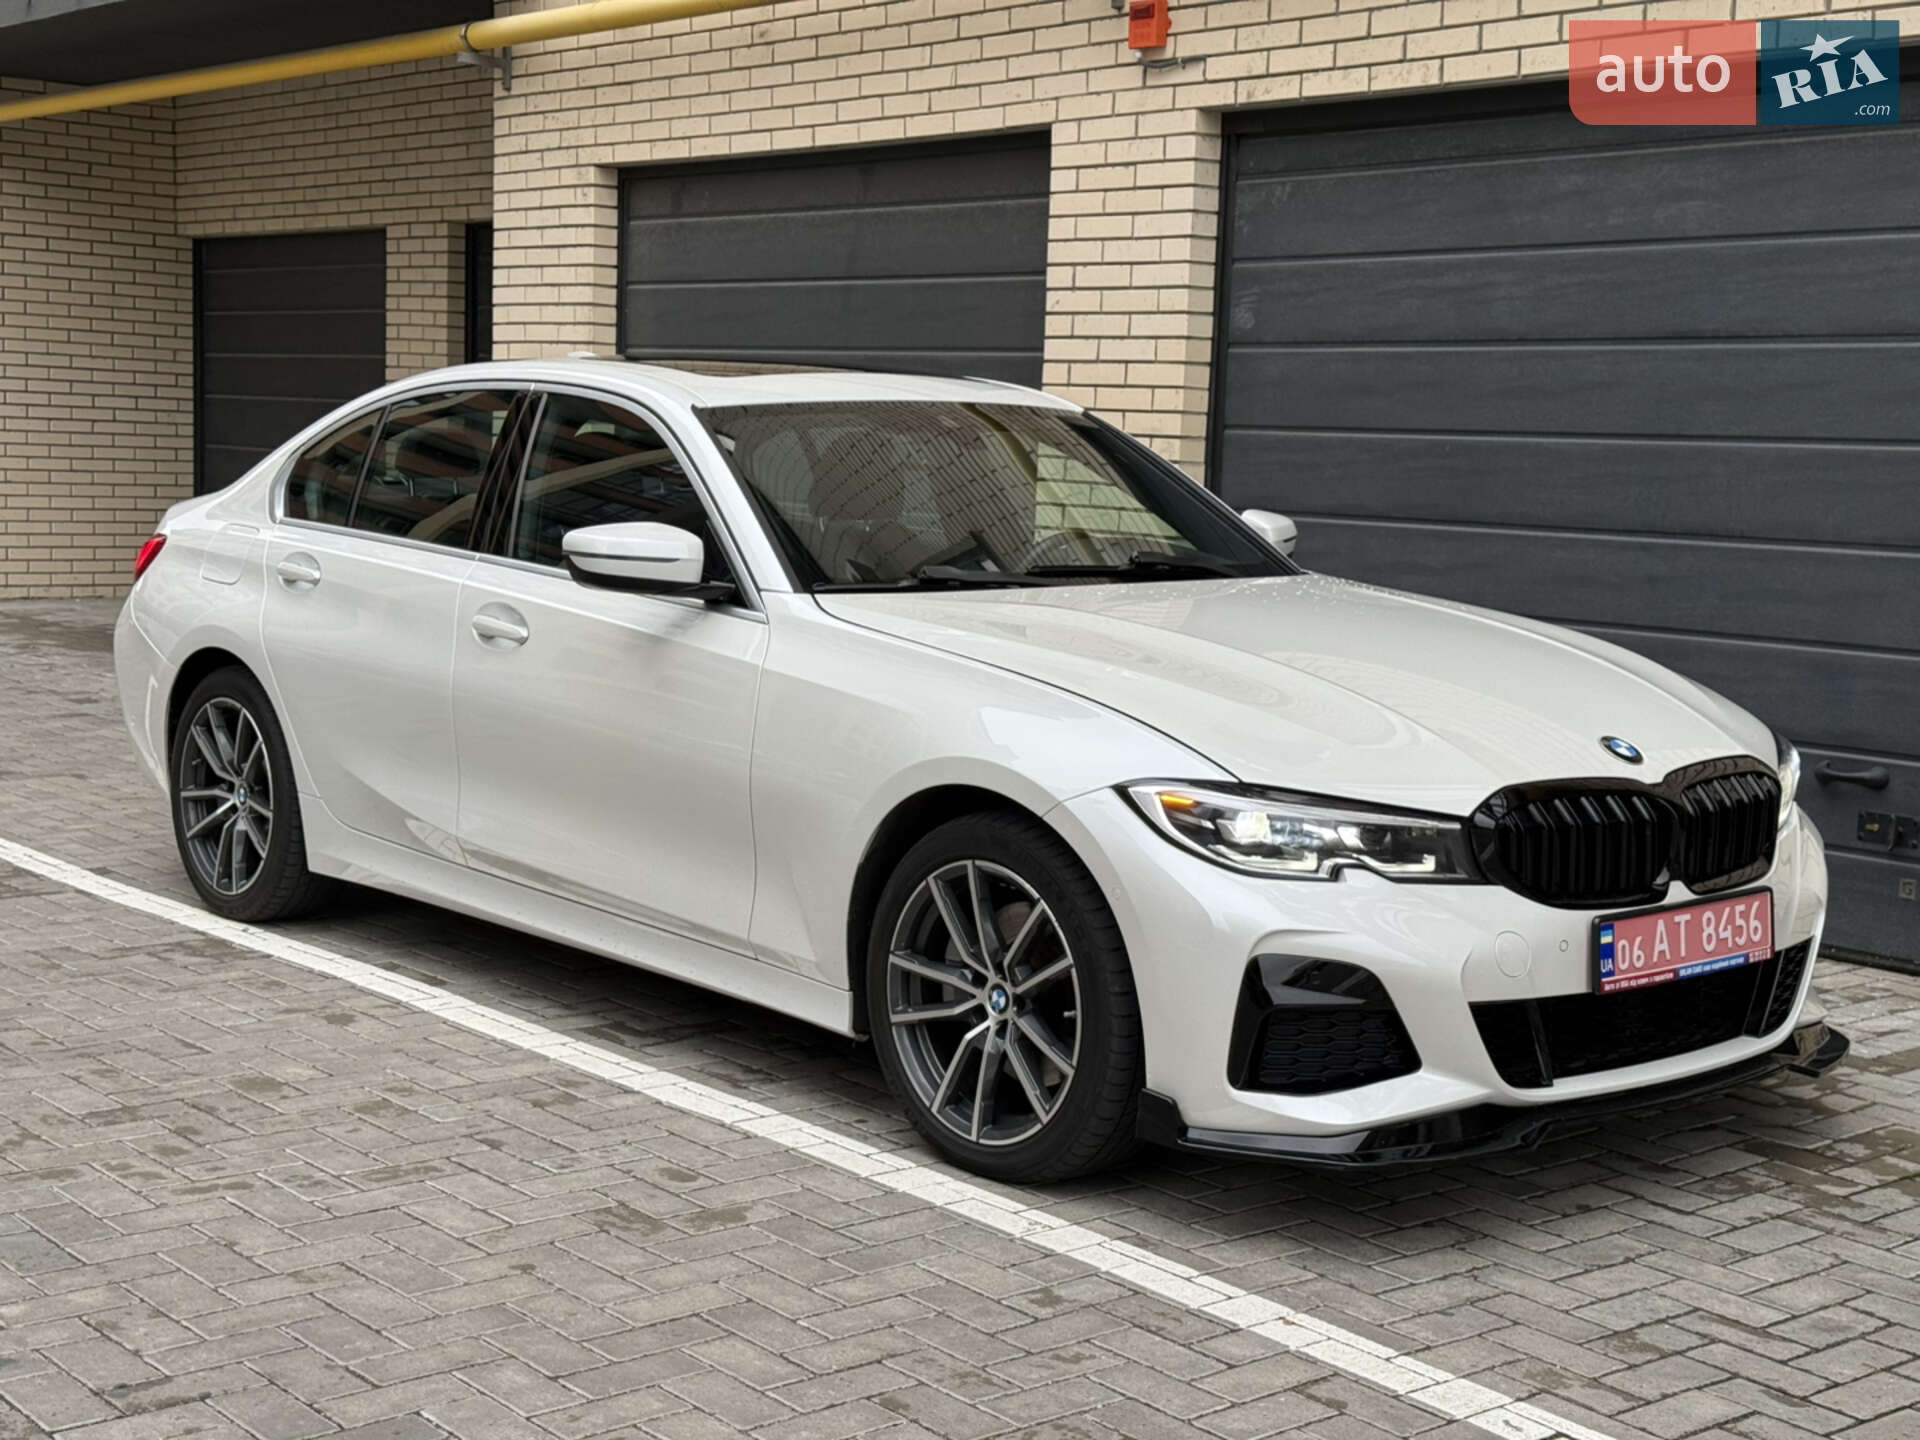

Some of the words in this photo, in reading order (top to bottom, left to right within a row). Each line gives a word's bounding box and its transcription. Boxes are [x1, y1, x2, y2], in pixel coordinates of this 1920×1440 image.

[1617, 936, 1645, 970] 06
[1653, 913, 1692, 962] AT
[1702, 901, 1763, 952] 8456
[1600, 958, 1614, 973] UA
